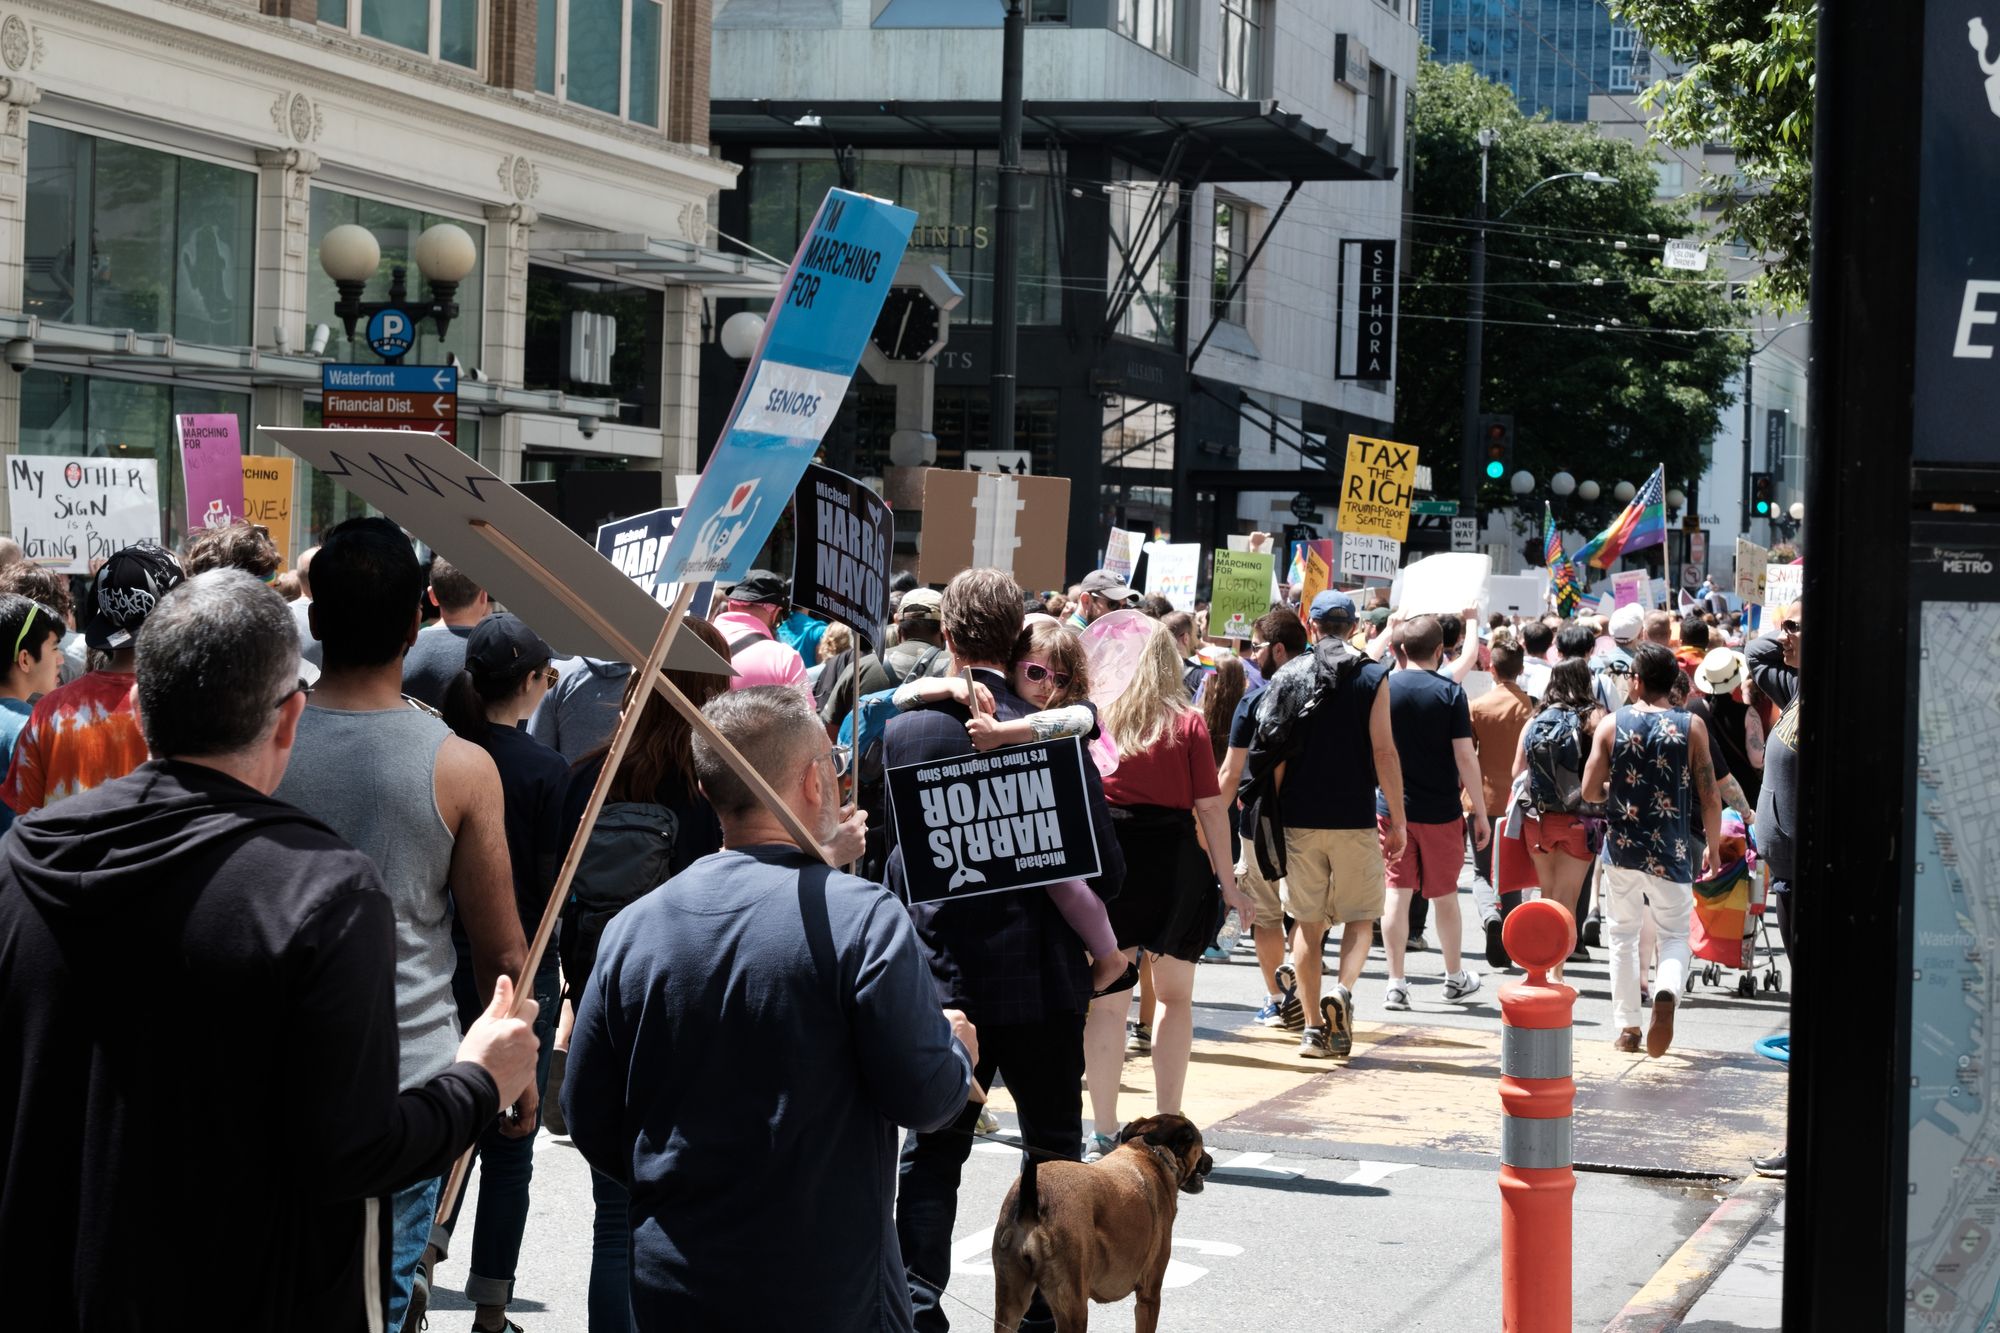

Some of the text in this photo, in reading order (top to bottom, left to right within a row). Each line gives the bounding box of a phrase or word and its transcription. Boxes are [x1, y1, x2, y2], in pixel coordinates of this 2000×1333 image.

[908, 225, 989, 249] INTS
[801, 235, 882, 284] MARCHING
[785, 272, 821, 310] FOR
[1368, 248, 1383, 373] SEPHORA
[329, 370, 395, 386] Waterfront
[328, 396, 414, 413] Financial Dist.
[764, 388, 822, 418] SENIORS
[183, 427, 228, 438] MARCHING
[184, 438, 201, 449] FOR
[1357, 441, 1411, 472] TAX
[64, 461, 147, 494] OTHER
[242, 468, 279, 481] CHING
[1367, 466, 1395, 480] THE
[816, 481, 851, 508] Michael
[1348, 475, 1412, 509] RICH
[1439, 505, 1452, 513] Ave
[86, 520, 93, 531] A
[1356, 514, 1393, 529] SEATTLE
[1454, 520, 1474, 529] ONE
[1700, 514, 1720, 525] itch
[816, 498, 885, 579] HARRIS
[1345, 534, 1397, 553] SIGN THE
[1454, 530, 1474, 539] WAY
[612, 535, 673, 578] HAR
[1216, 559, 1262, 571] MARCHING
[1344, 551, 1398, 576] PETITION
[1216, 566, 1232, 575] FOR
[1943, 560, 1993, 574] METRO
[816, 542, 883, 624] MAYOR
[1218, 577, 1264, 593] LGBTQ+
[1222, 594, 1267, 613] RIGHTS
[916, 748, 1048, 782] It's Time to Right the Ship
[919, 768, 1056, 828] MAYOR
[928, 809, 1064, 873] HARRIS
[1015, 850, 1066, 872] Michael
[1918, 930, 1983, 946] Waterfront
